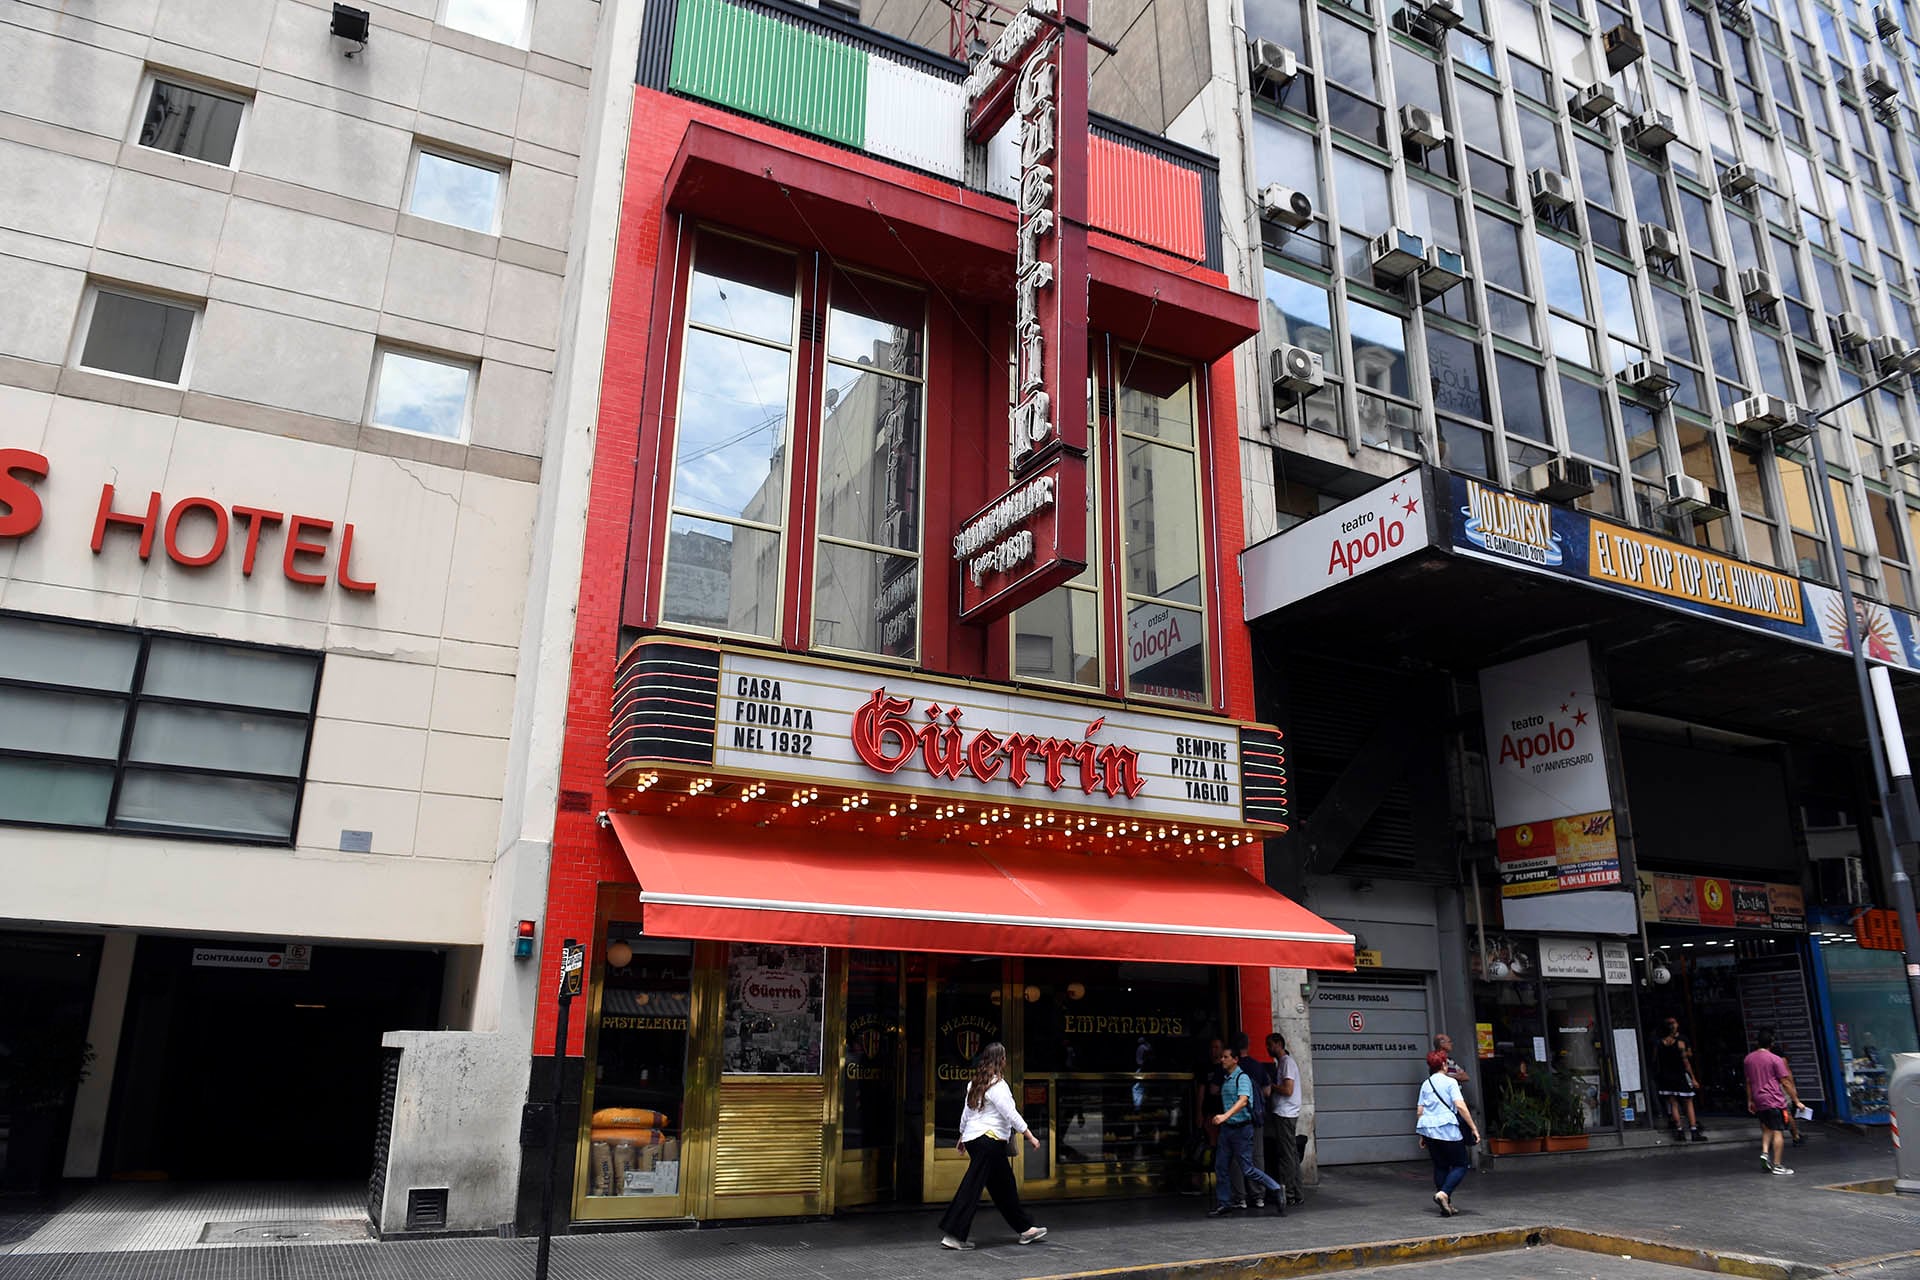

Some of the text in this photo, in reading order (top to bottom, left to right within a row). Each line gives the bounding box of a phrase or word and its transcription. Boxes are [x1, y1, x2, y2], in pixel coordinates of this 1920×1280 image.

[1341, 511, 1374, 533] teatro
[90, 483, 376, 595] HOTEL
[1328, 516, 1404, 576] Apolo
[1485, 534, 1546, 563] EL CANDIDATO 2019
[1595, 530, 1617, 577] EL
[1613, 535, 1645, 584] TOP
[1644, 544, 1674, 591] TOP
[1673, 551, 1703, 598] TOP
[1702, 558, 1734, 604] DEL
[1729, 565, 1780, 615] HUMOR
[737, 676, 781, 701] CASA
[736, 701, 813, 730] FONDATA
[1511, 715, 1544, 732] teatro
[734, 727, 813, 755] NEL 1932
[1176, 737, 1227, 760] SEMPRE
[1498, 721, 1575, 769] Apolo
[1171, 757, 1228, 781] PIZZA AL
[1544, 753, 1594, 772] ANIVERSARIO
[1185, 781, 1229, 802] TAGLIO
[1588, 870, 1620, 883] ATELIER
[196, 953, 264, 963] CONTRAMANO
[1318, 993, 1390, 1002] COCHERAS PRIVADAS
[601, 1016, 687, 1031] PASTELERIA
[940, 1015, 999, 1037] PIZZERIA
[1064, 1015, 1185, 1036] EMPANADAS
